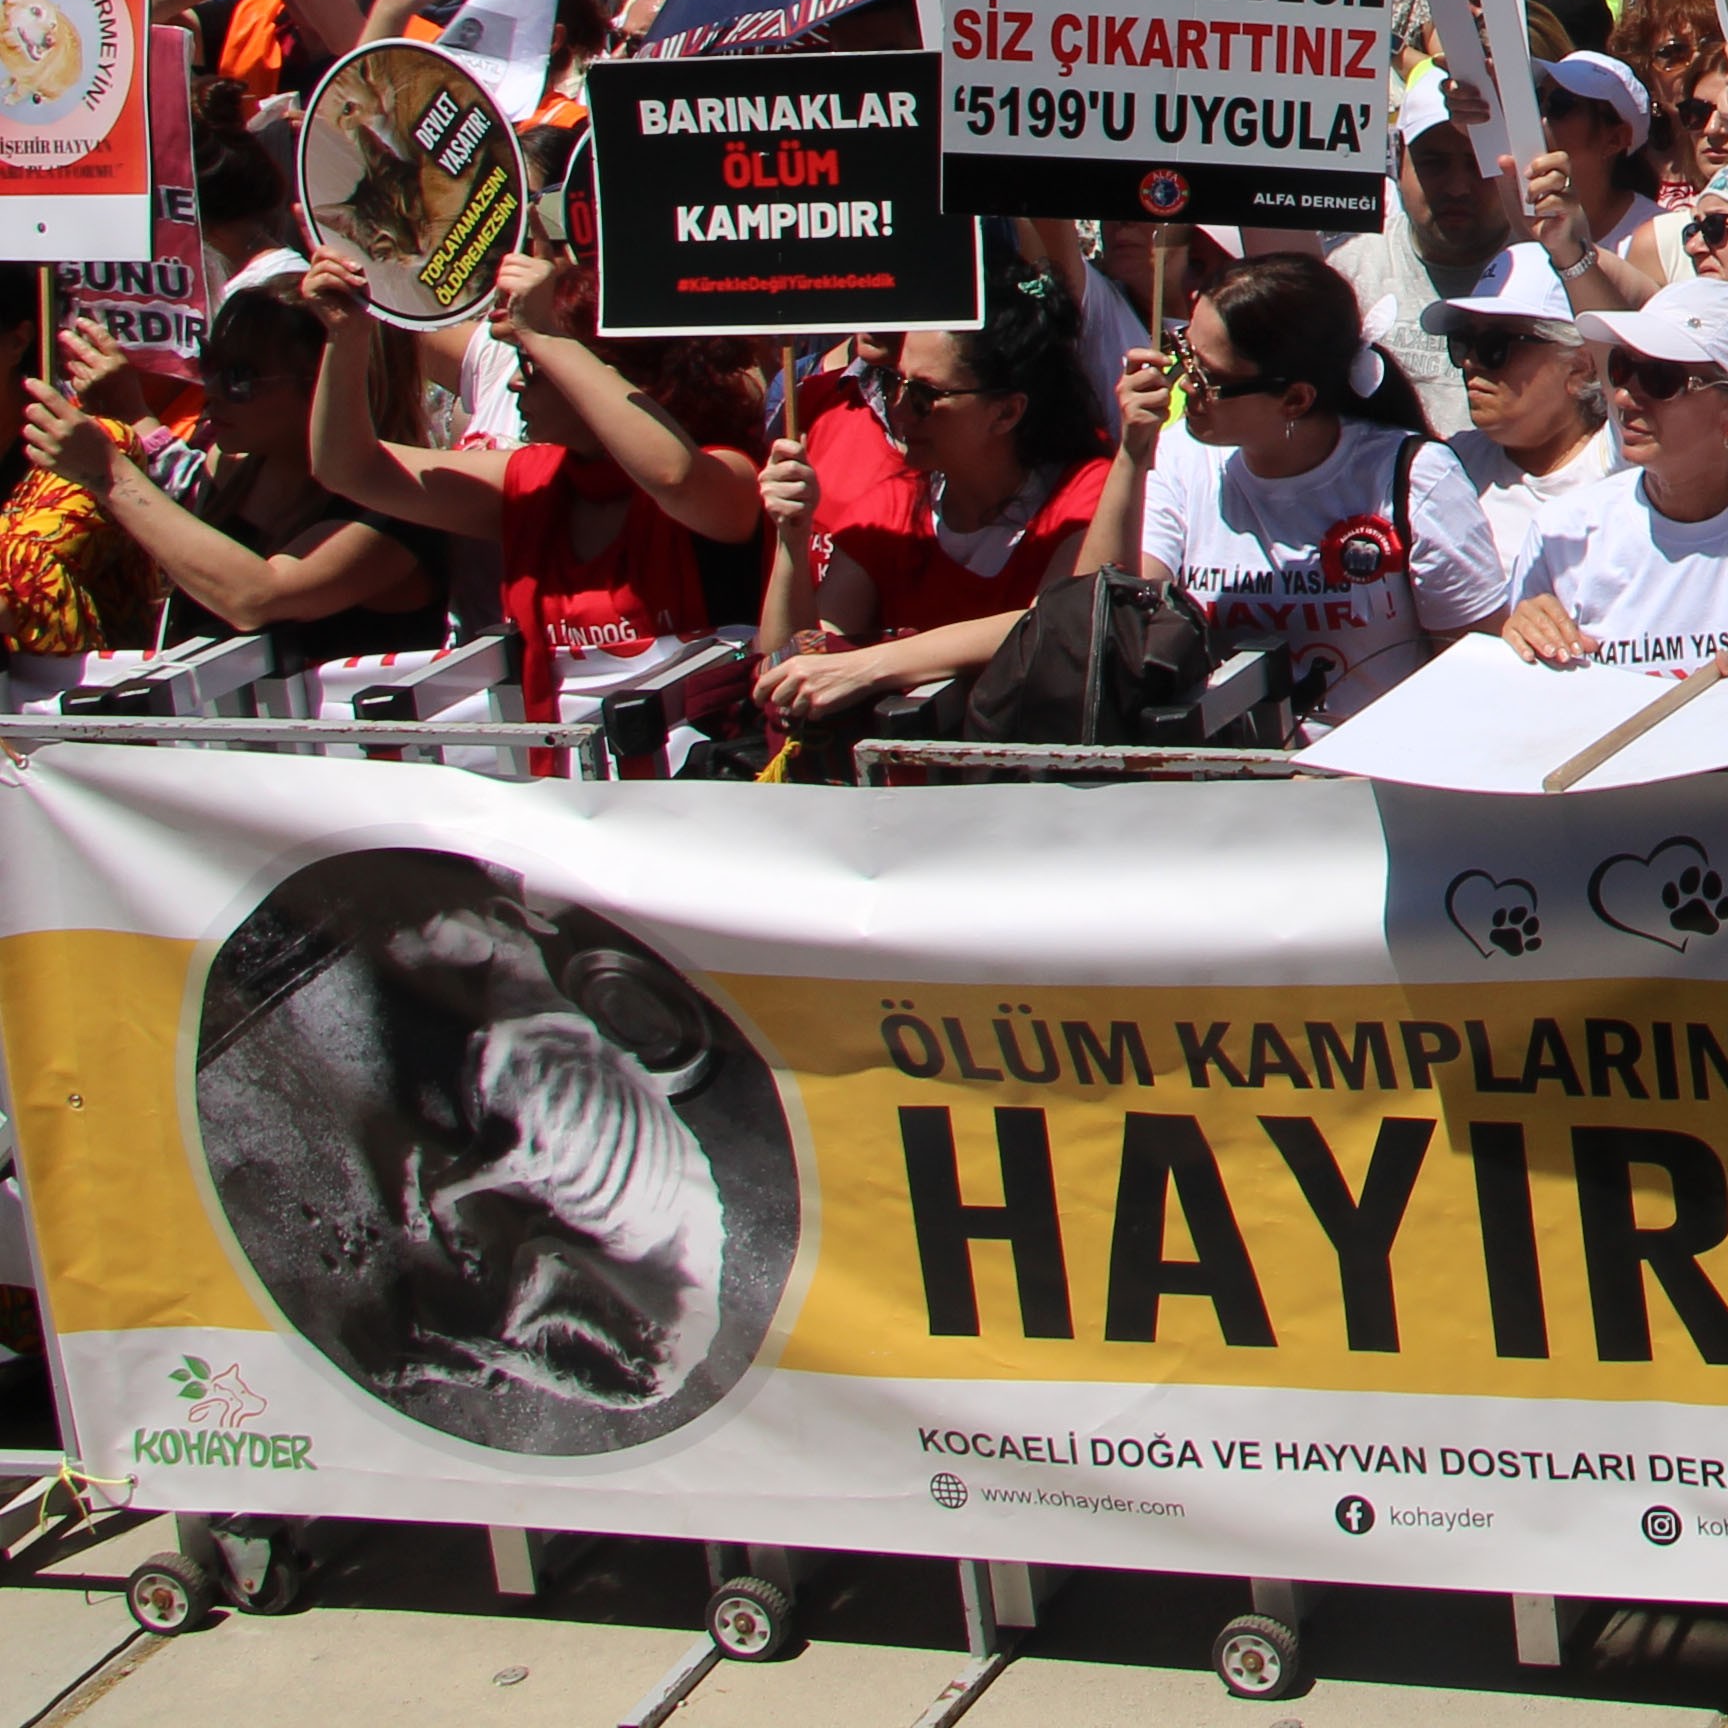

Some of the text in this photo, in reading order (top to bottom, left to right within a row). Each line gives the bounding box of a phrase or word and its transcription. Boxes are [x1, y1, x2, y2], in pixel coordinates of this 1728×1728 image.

[951, 0, 1377, 79] SİZ ÇIKARTTINIZ
[636, 91, 919, 136] BARINAKLAR
[722, 142, 840, 188] ÖLÜM
[675, 200, 894, 243] KAMPIDIR!
[1254, 192, 1377, 211] ALFA DERNEĞİ
[676, 274, 895, 294] #KürekleDeğilYürekleGeldik
[880, 999, 1155, 1088] ÖLÜM
[917, 1426, 1080, 1467] KOCAELİ
[1090, 1433, 1203, 1472] DOĞA
[1211, 1439, 1264, 1473] VE
[1275, 1442, 1429, 1476] HAYVAN
[1440, 1448, 1636, 1483] DOSTLARI
[980, 1485, 1186, 1519] www.kohayder.com
[1388, 1504, 1494, 1533] kohayder
